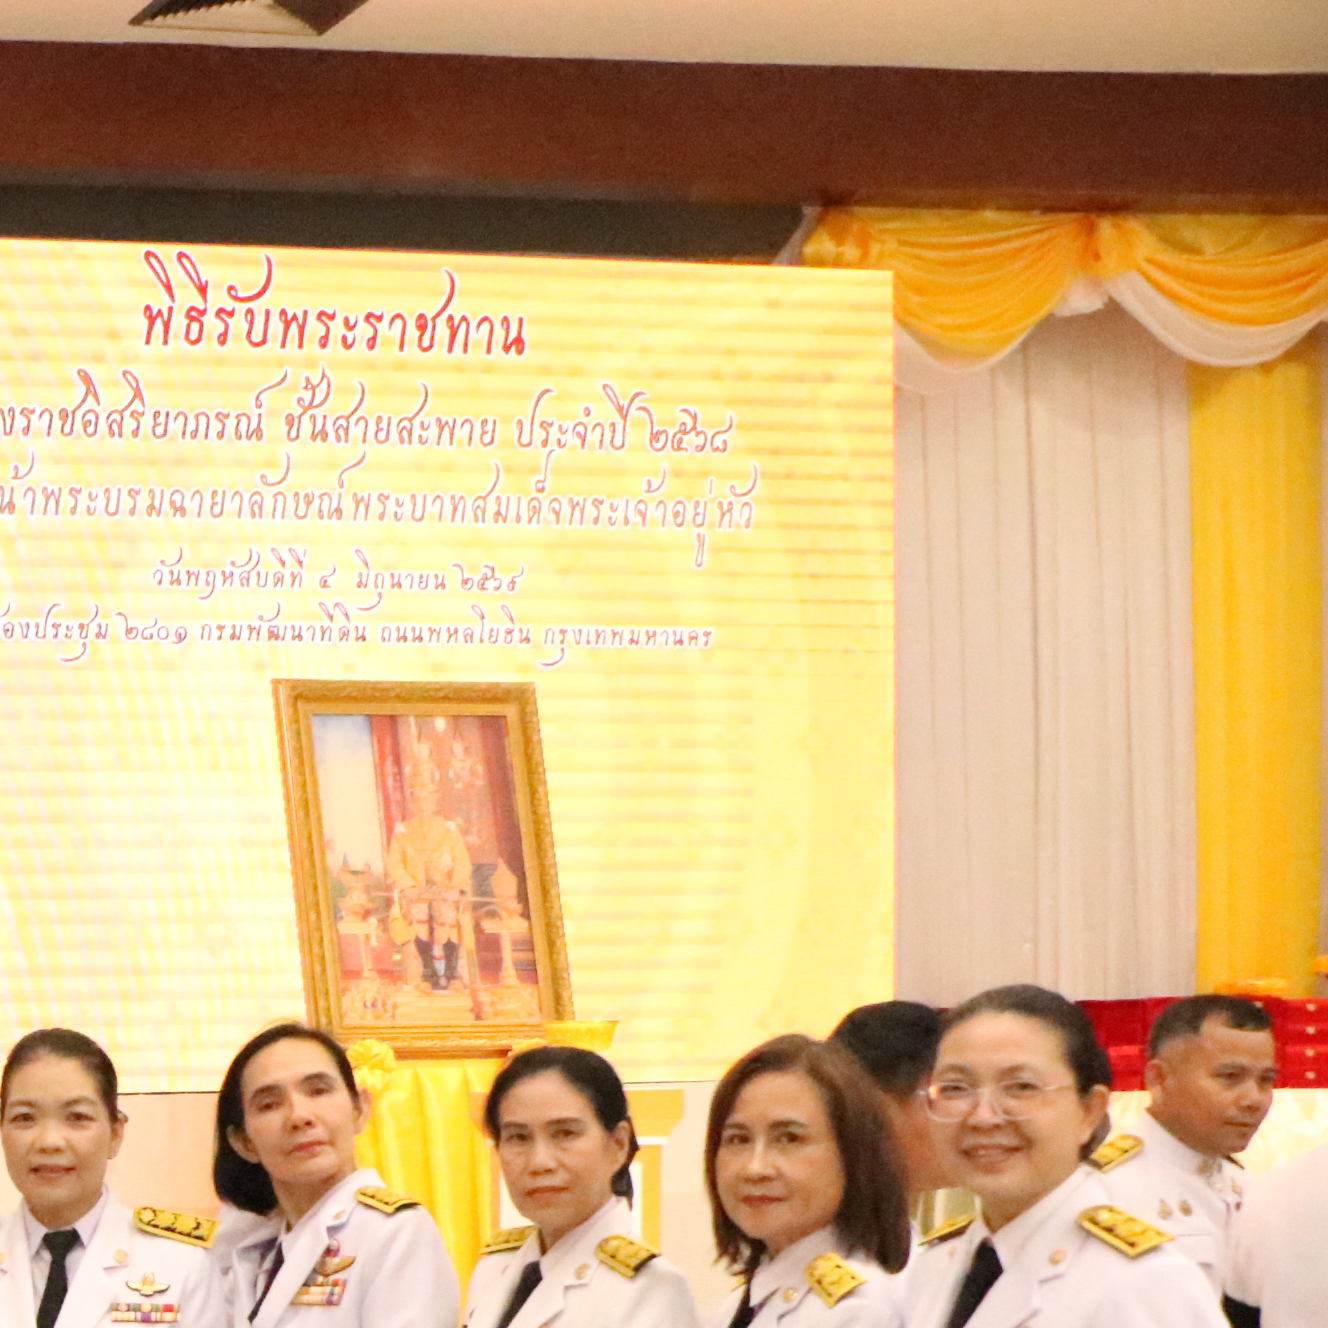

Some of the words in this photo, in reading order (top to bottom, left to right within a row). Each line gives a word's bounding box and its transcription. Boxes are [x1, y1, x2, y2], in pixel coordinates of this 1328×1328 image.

[143, 250, 526, 356] พิธีรับพระราชทาน
[284, 365, 498, 446] ชั้นสายสะพาย
[515, 384, 646, 452] ประจำปี
[635, 405, 734, 453] ๒๕๖๘
[152, 546, 307, 600] วันพฤหัสบดีที่
[318, 565, 337, 590] ๔
[354, 549, 446, 611] มิถุนายน
[114, 611, 188, 645] ๒๘๐๑
[200, 601, 367, 645] กรมพัฒนาที่ดิน
[380, 603, 531, 645] ถนนพหลโยธิน
[538, 627, 713, 667] กรุงเทพมหานคร
